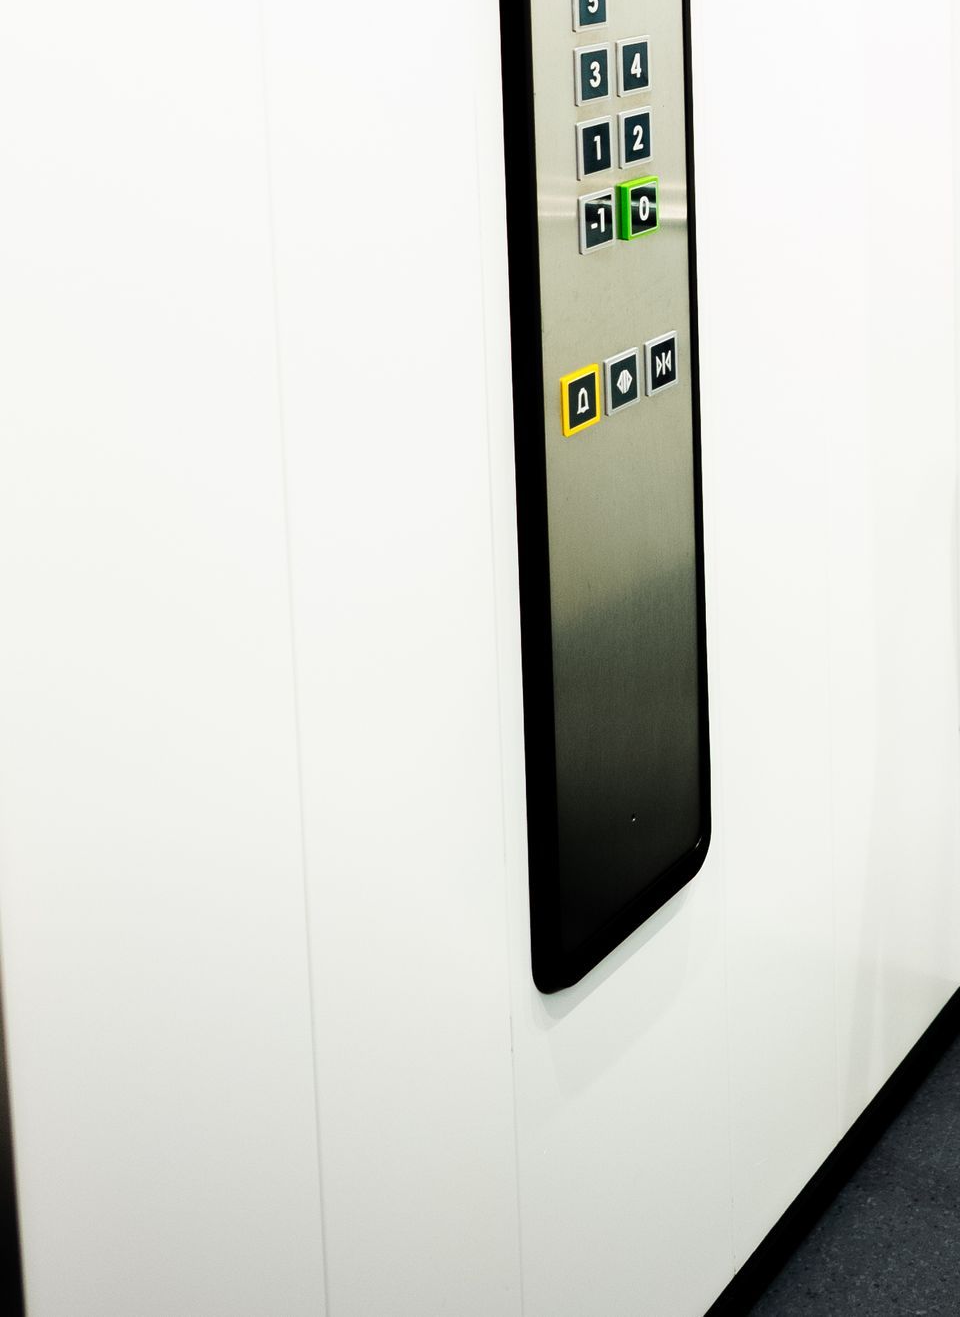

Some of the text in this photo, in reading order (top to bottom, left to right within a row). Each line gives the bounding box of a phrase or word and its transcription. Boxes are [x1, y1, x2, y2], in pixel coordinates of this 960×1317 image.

[589, 60, 602, 89] 3
[630, 52, 642, 79] 4
[593, 134, 602, 161] 1
[632, 124, 644, 152] 2
[590, 206, 606, 233] -1
[638, 195, 650, 222] 0
